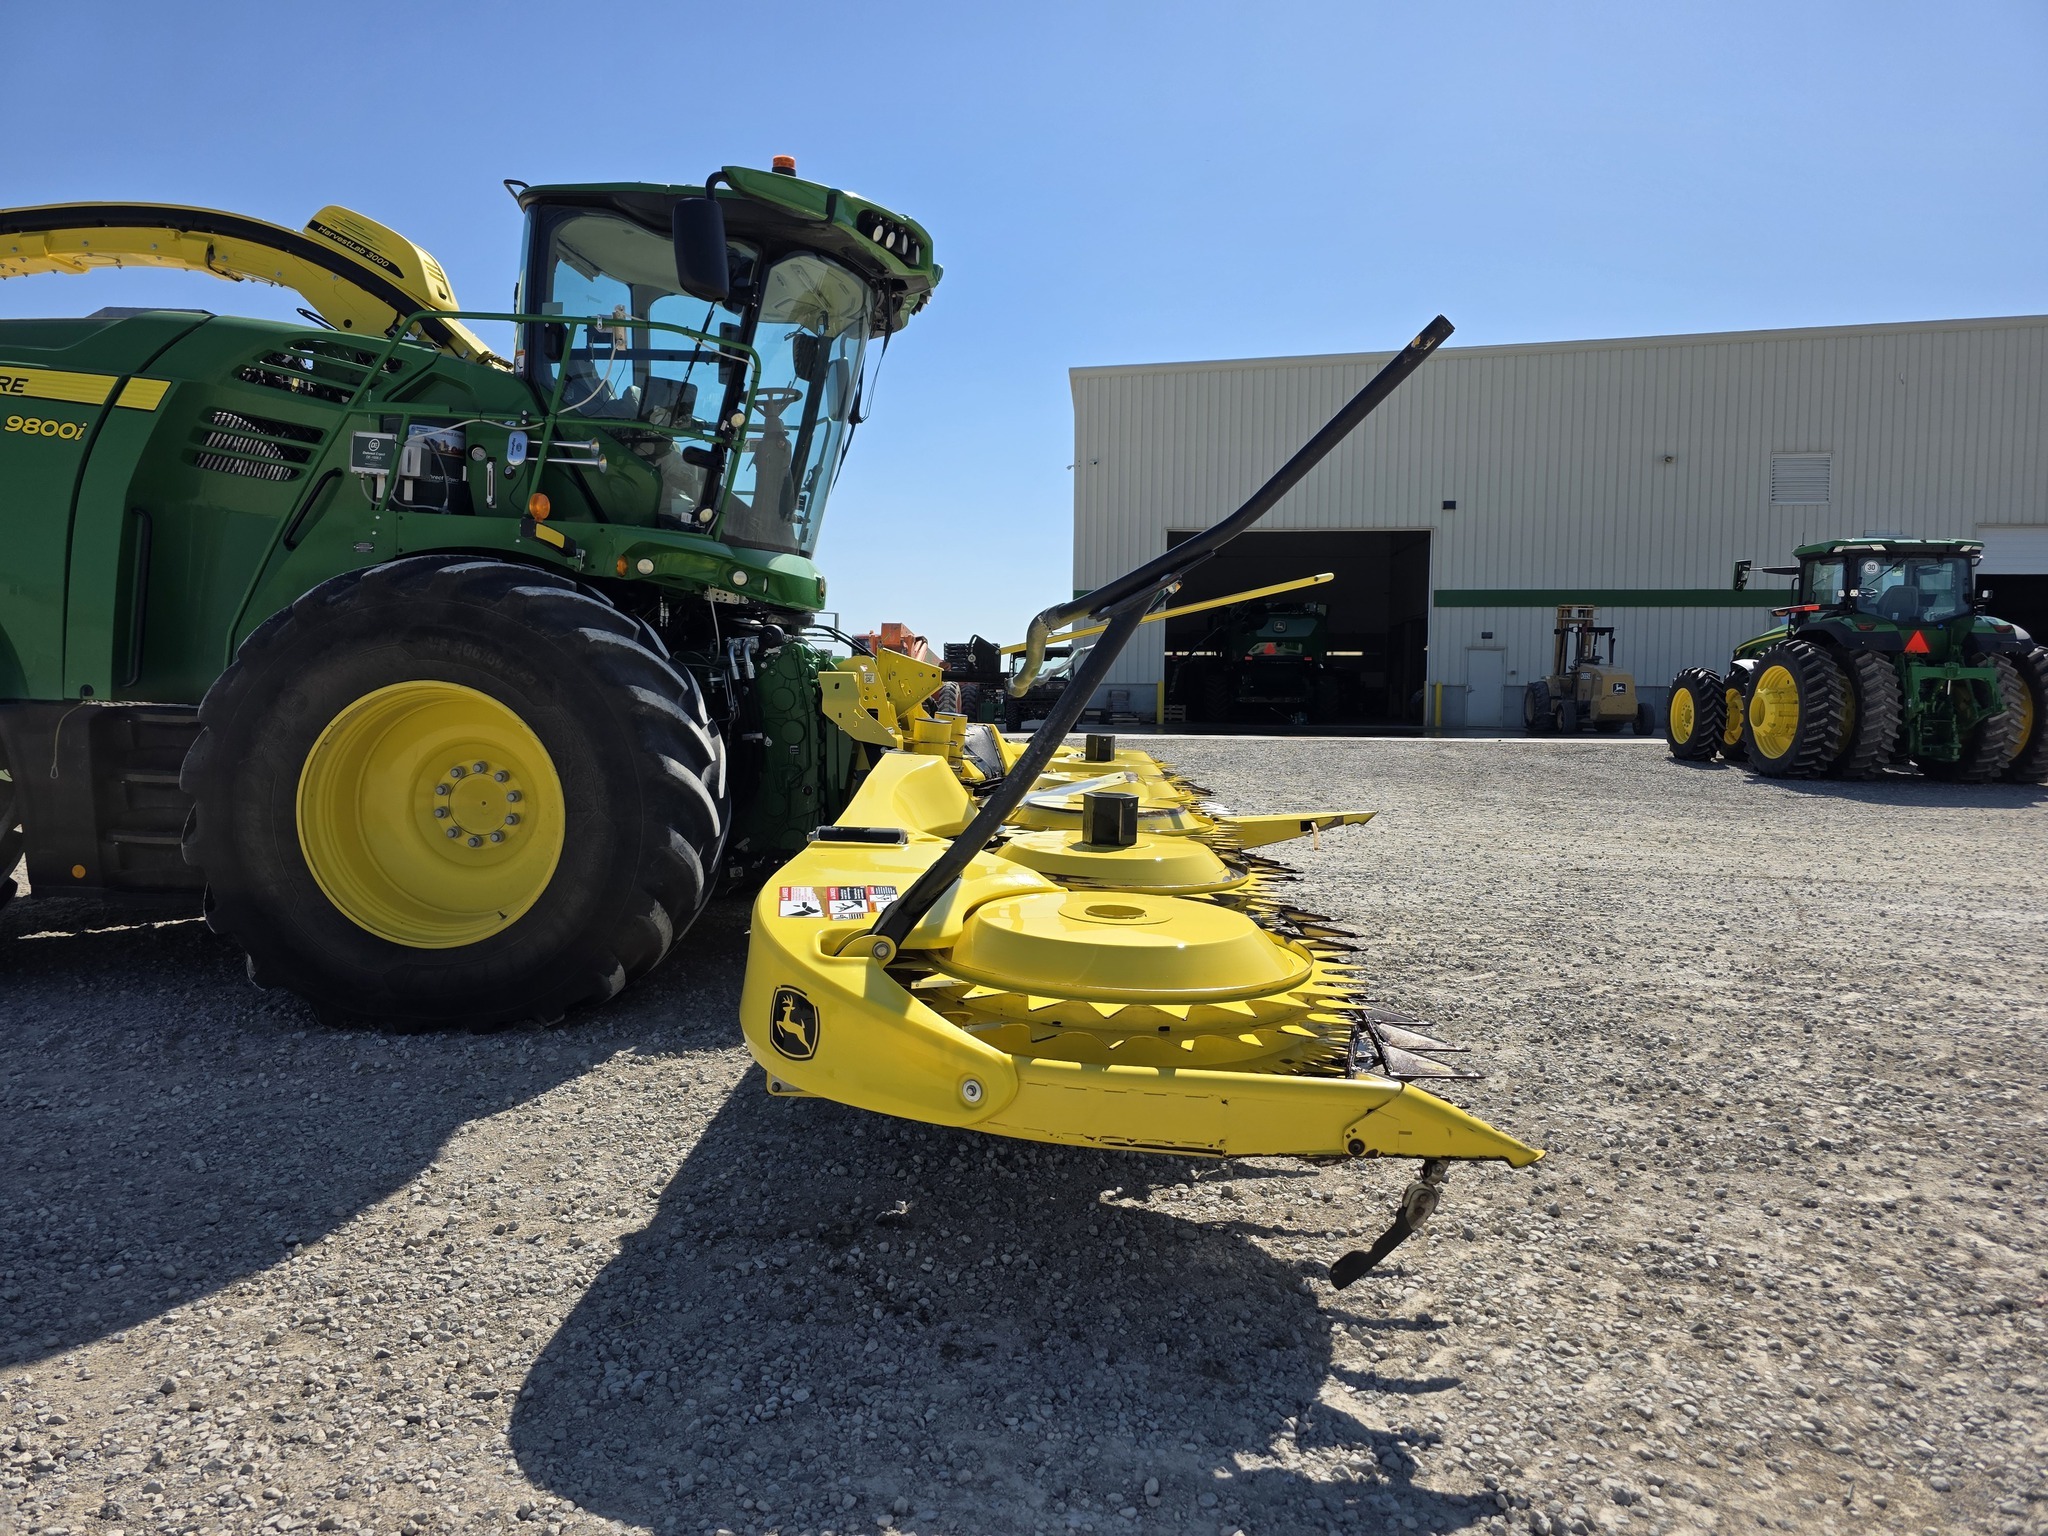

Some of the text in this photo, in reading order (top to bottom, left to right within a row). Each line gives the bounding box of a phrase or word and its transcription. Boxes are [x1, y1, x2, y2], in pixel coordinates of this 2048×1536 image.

[317, 225, 390, 268] HarvestLab 3000
[4, 415, 88, 441] 9800i
[1867, 563, 1876, 571] 30
